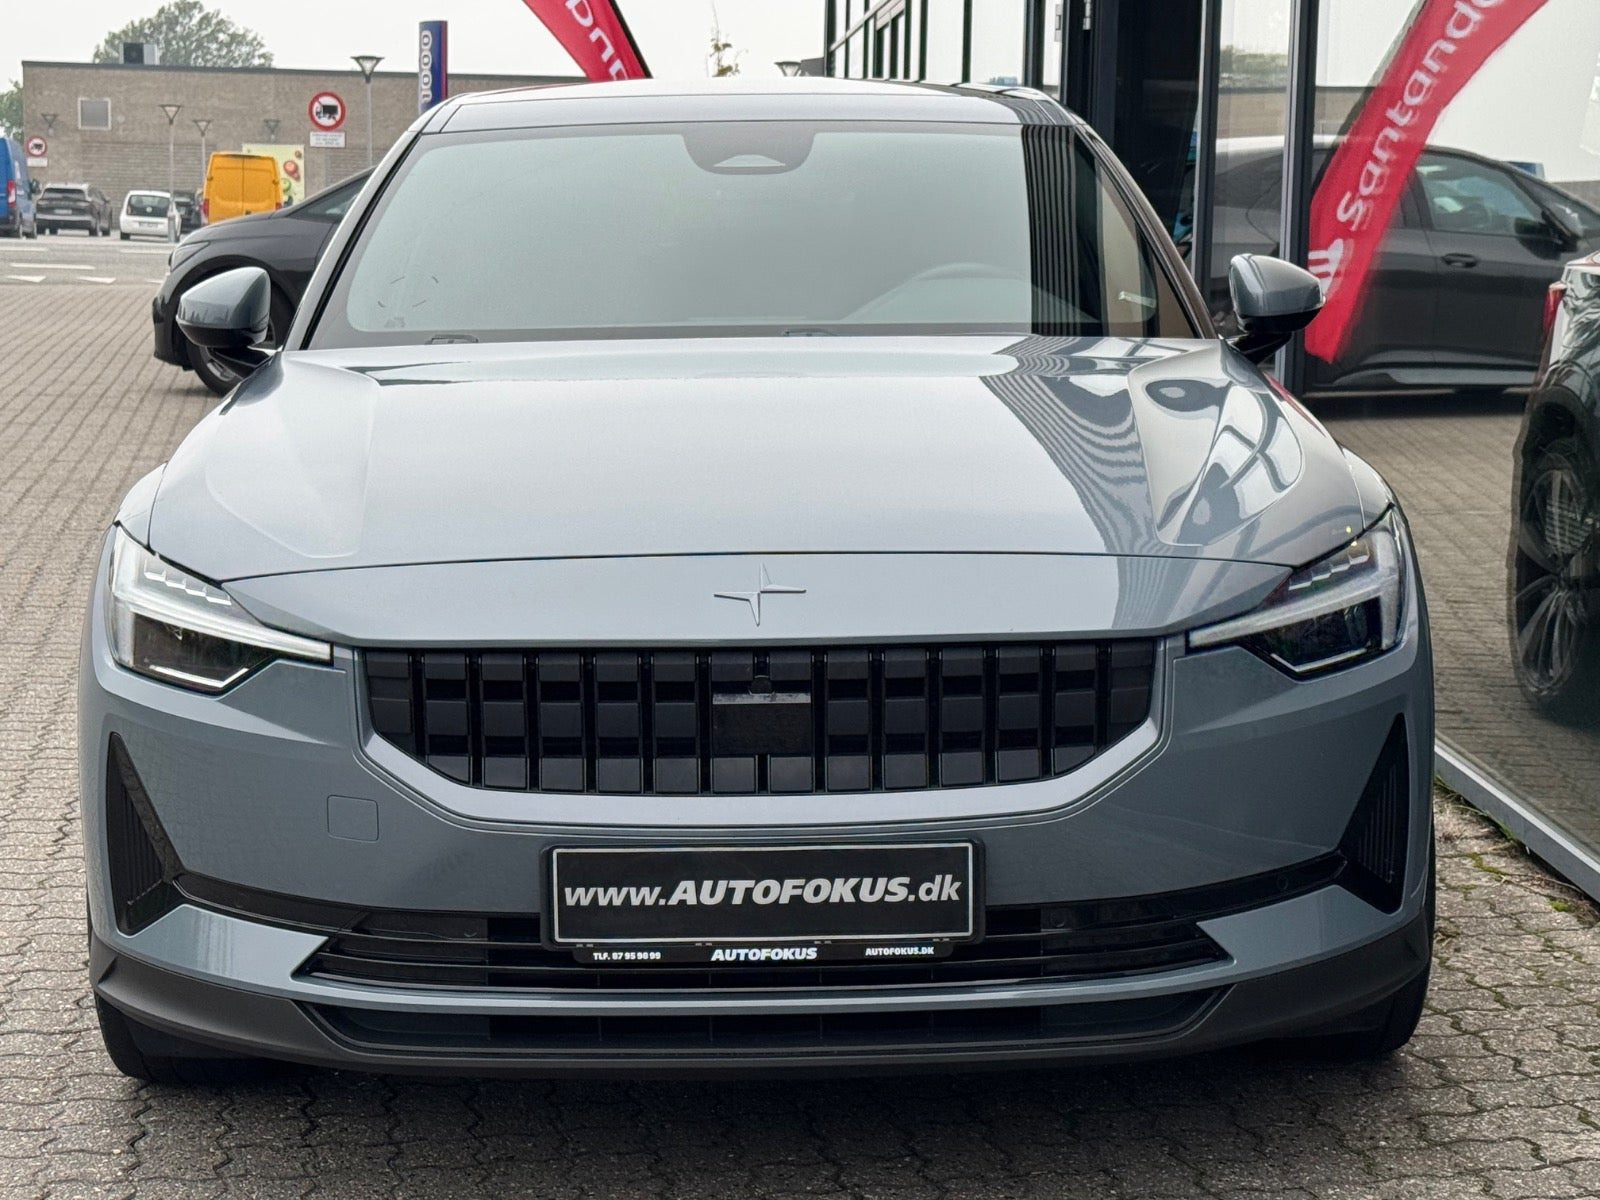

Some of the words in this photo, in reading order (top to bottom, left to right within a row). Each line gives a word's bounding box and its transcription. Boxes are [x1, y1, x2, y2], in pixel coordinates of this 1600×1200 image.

[564, 874, 961, 907] www.AUTOFOKUS.dk
[592, 952, 611, 960] TLF.
[711, 947, 818, 961] AUTOFOKUS
[865, 946, 935, 956] AUTOFOKUS.DK
